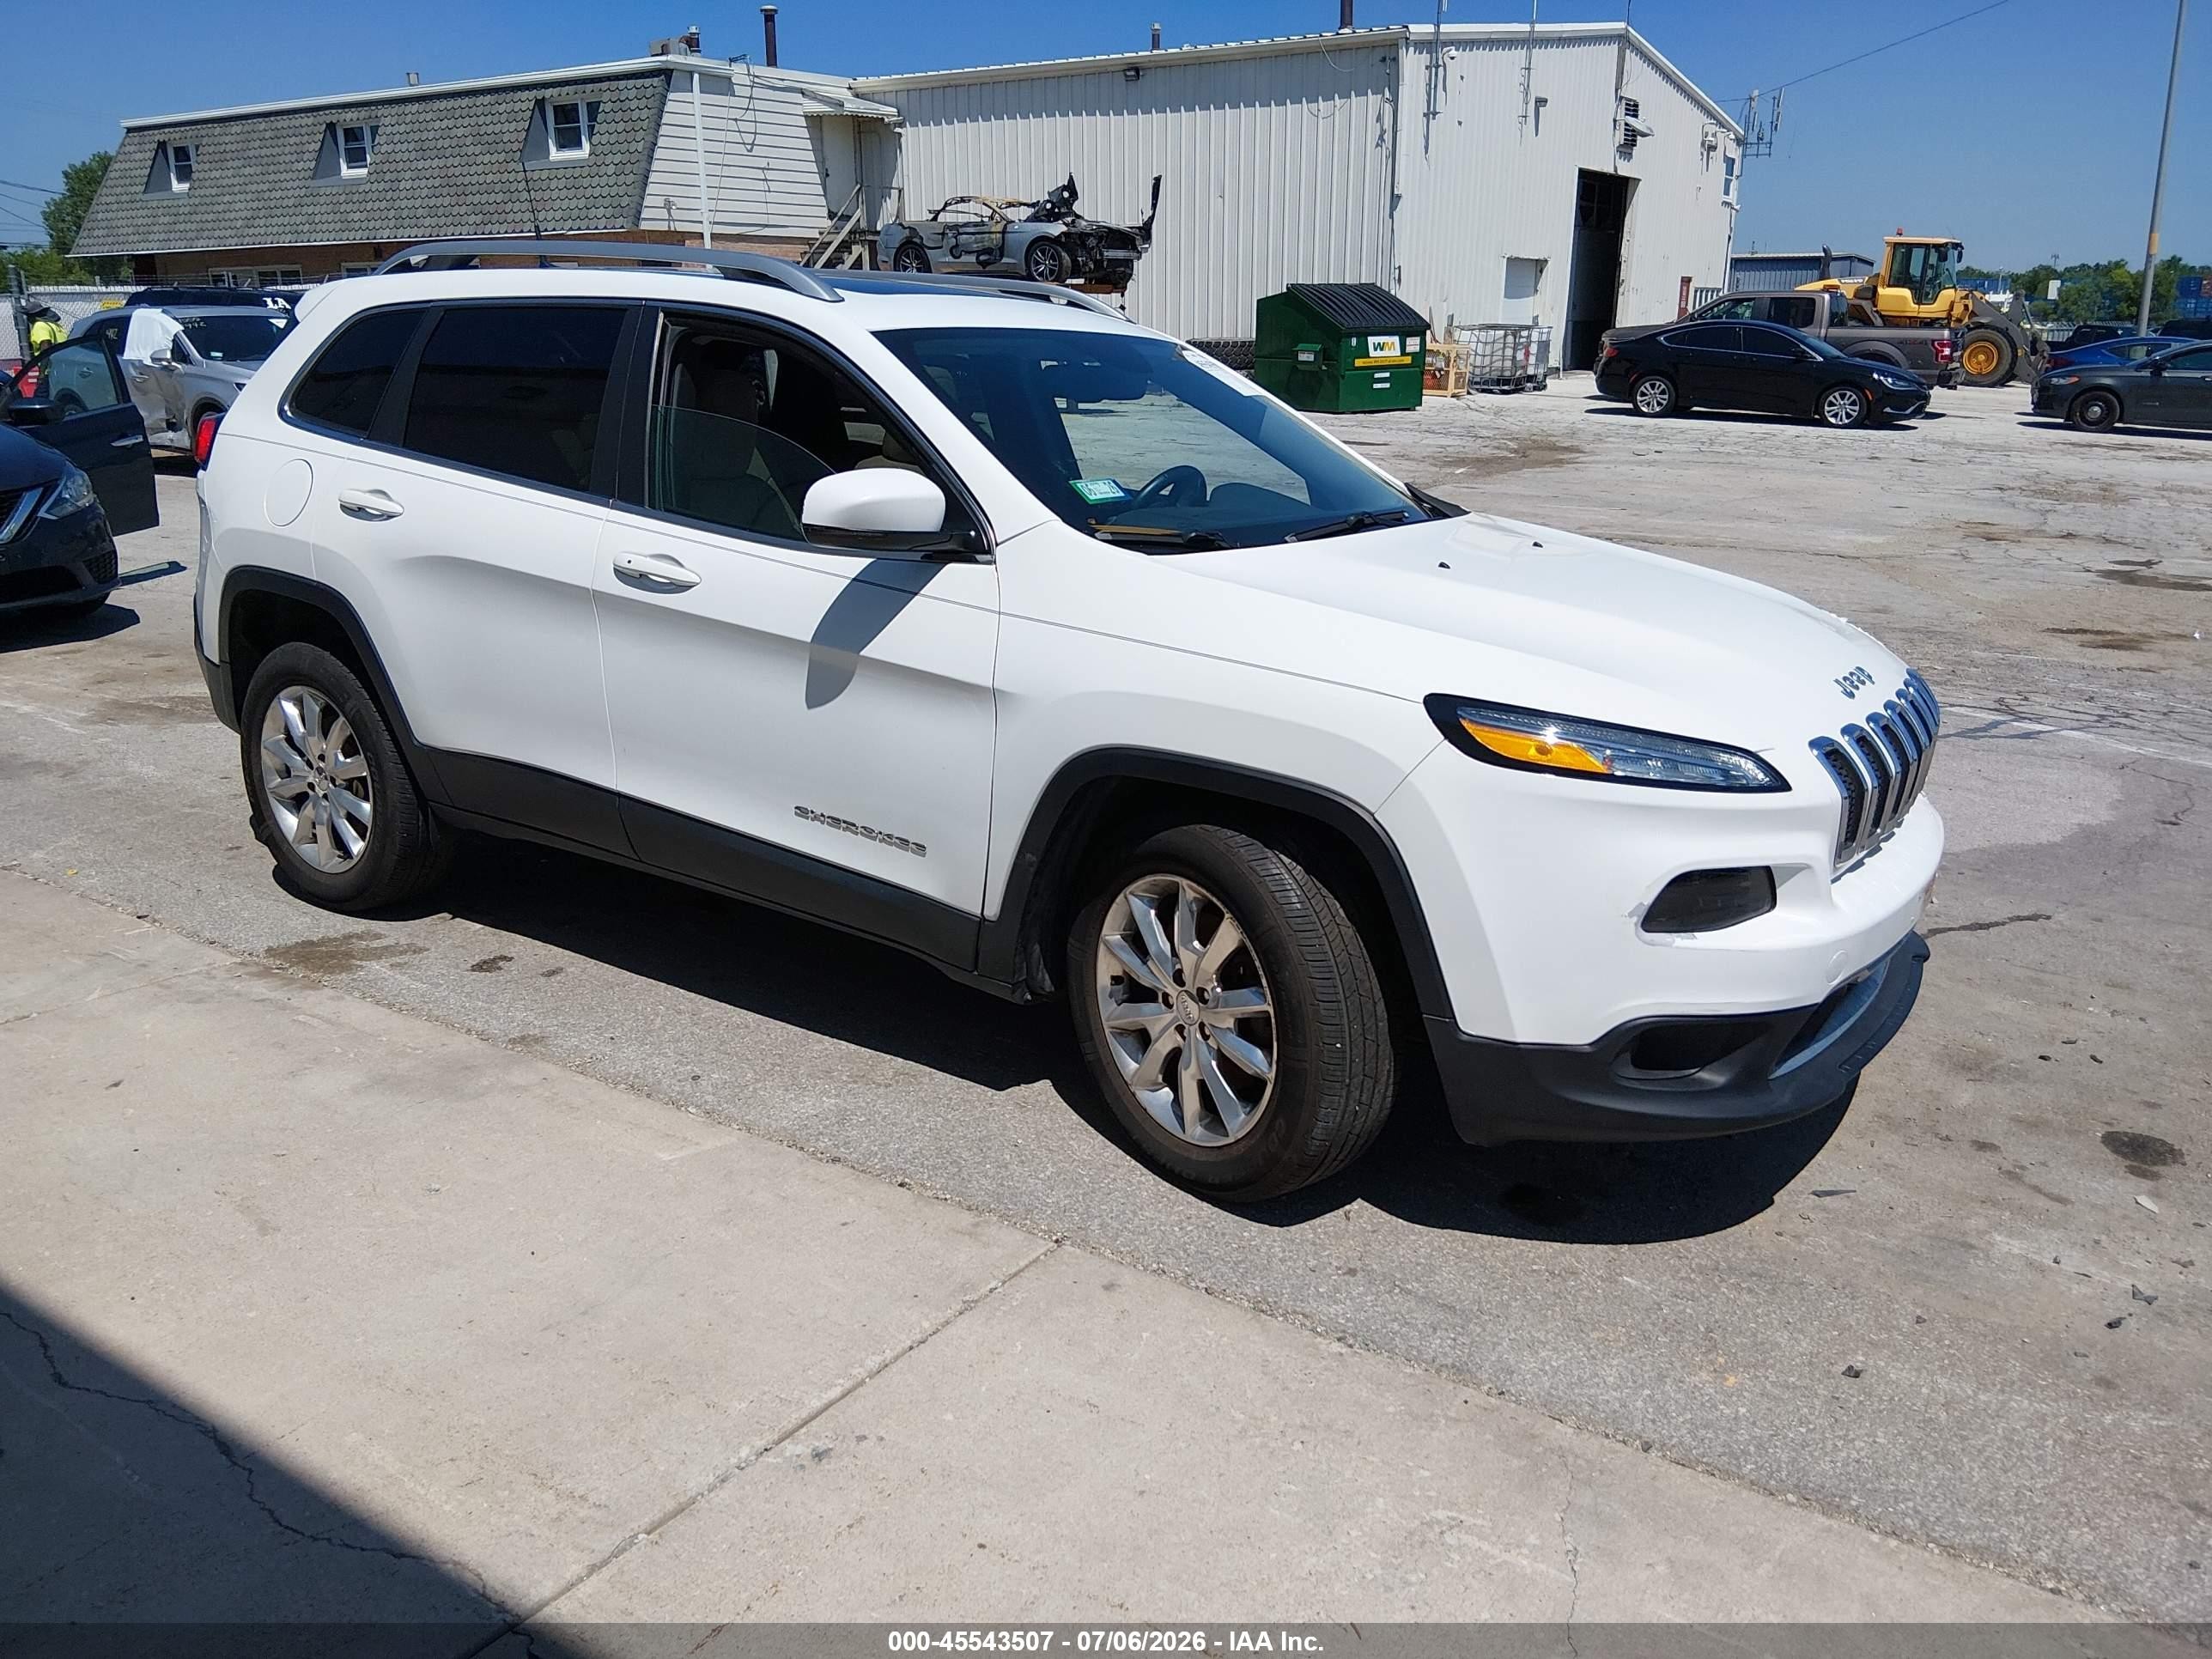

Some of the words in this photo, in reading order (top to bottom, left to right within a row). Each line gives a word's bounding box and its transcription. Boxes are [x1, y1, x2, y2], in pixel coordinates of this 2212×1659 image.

[1372, 341, 1395, 352] WM
[1832, 665, 1875, 700] Jeep
[793, 805, 927, 859] CHEROKEE
